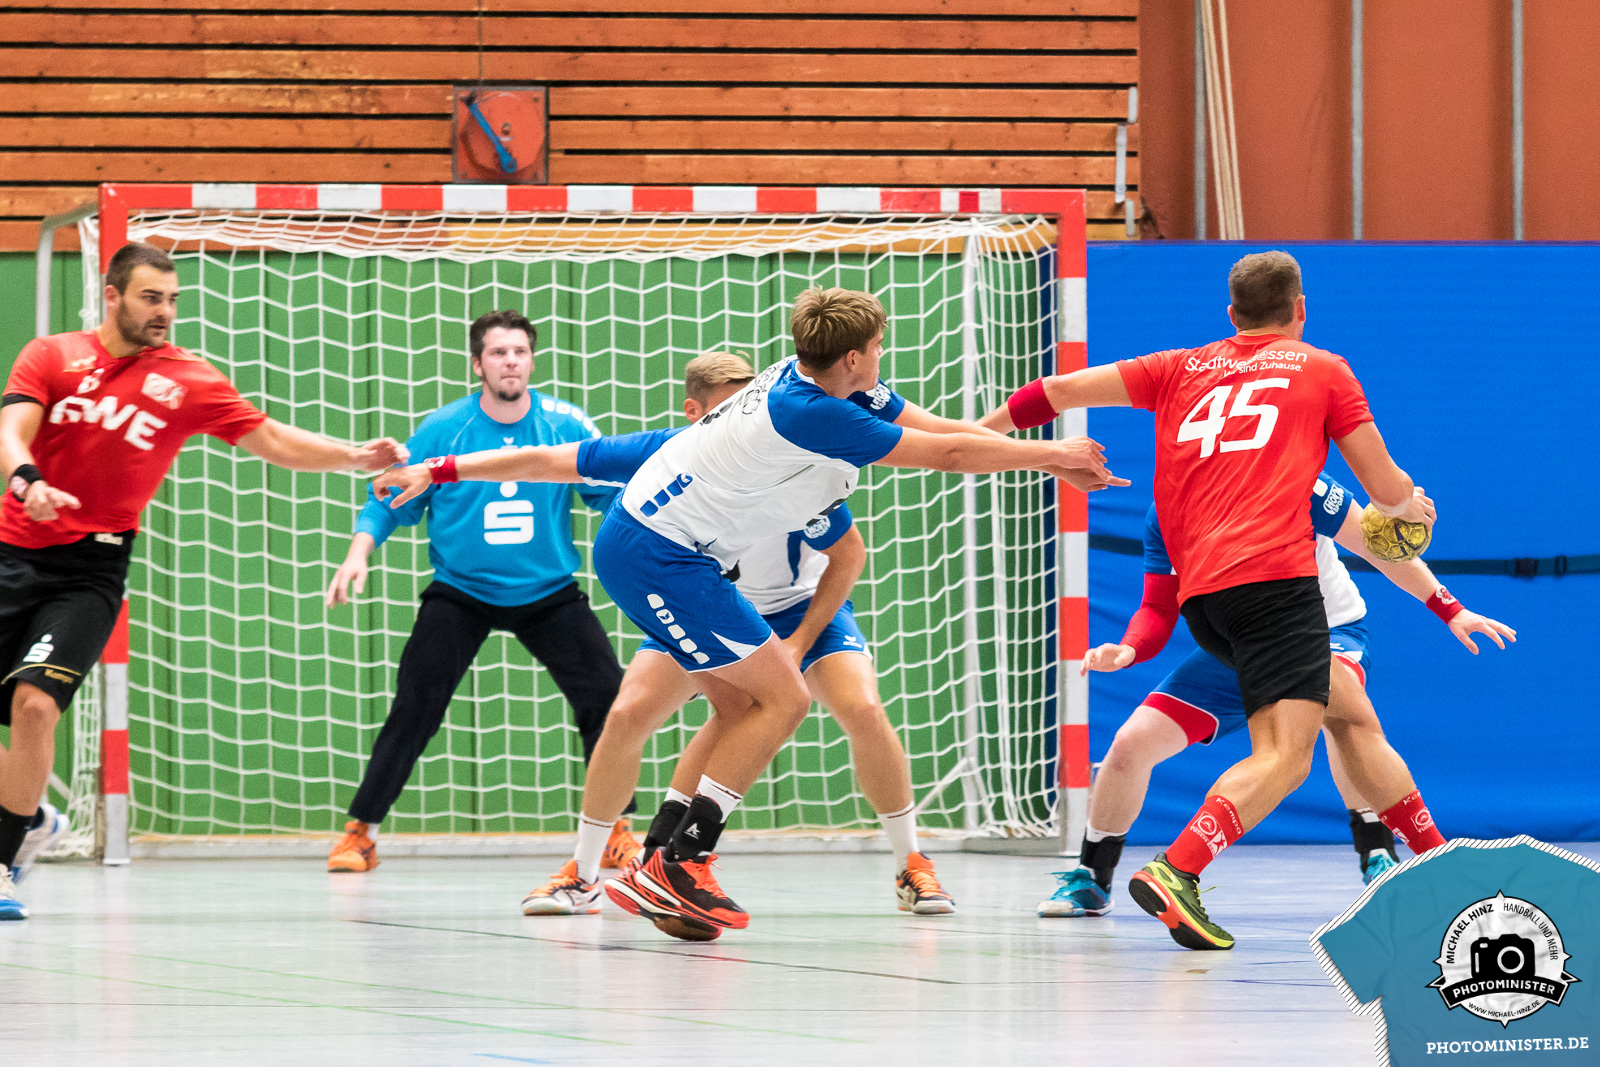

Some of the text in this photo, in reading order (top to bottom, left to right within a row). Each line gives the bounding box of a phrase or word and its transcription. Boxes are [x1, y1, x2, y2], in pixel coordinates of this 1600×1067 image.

[1238, 362, 1258, 374] sind
[1259, 361, 1304, 373] Zuhause.
[1177, 377, 1290, 459] 45
